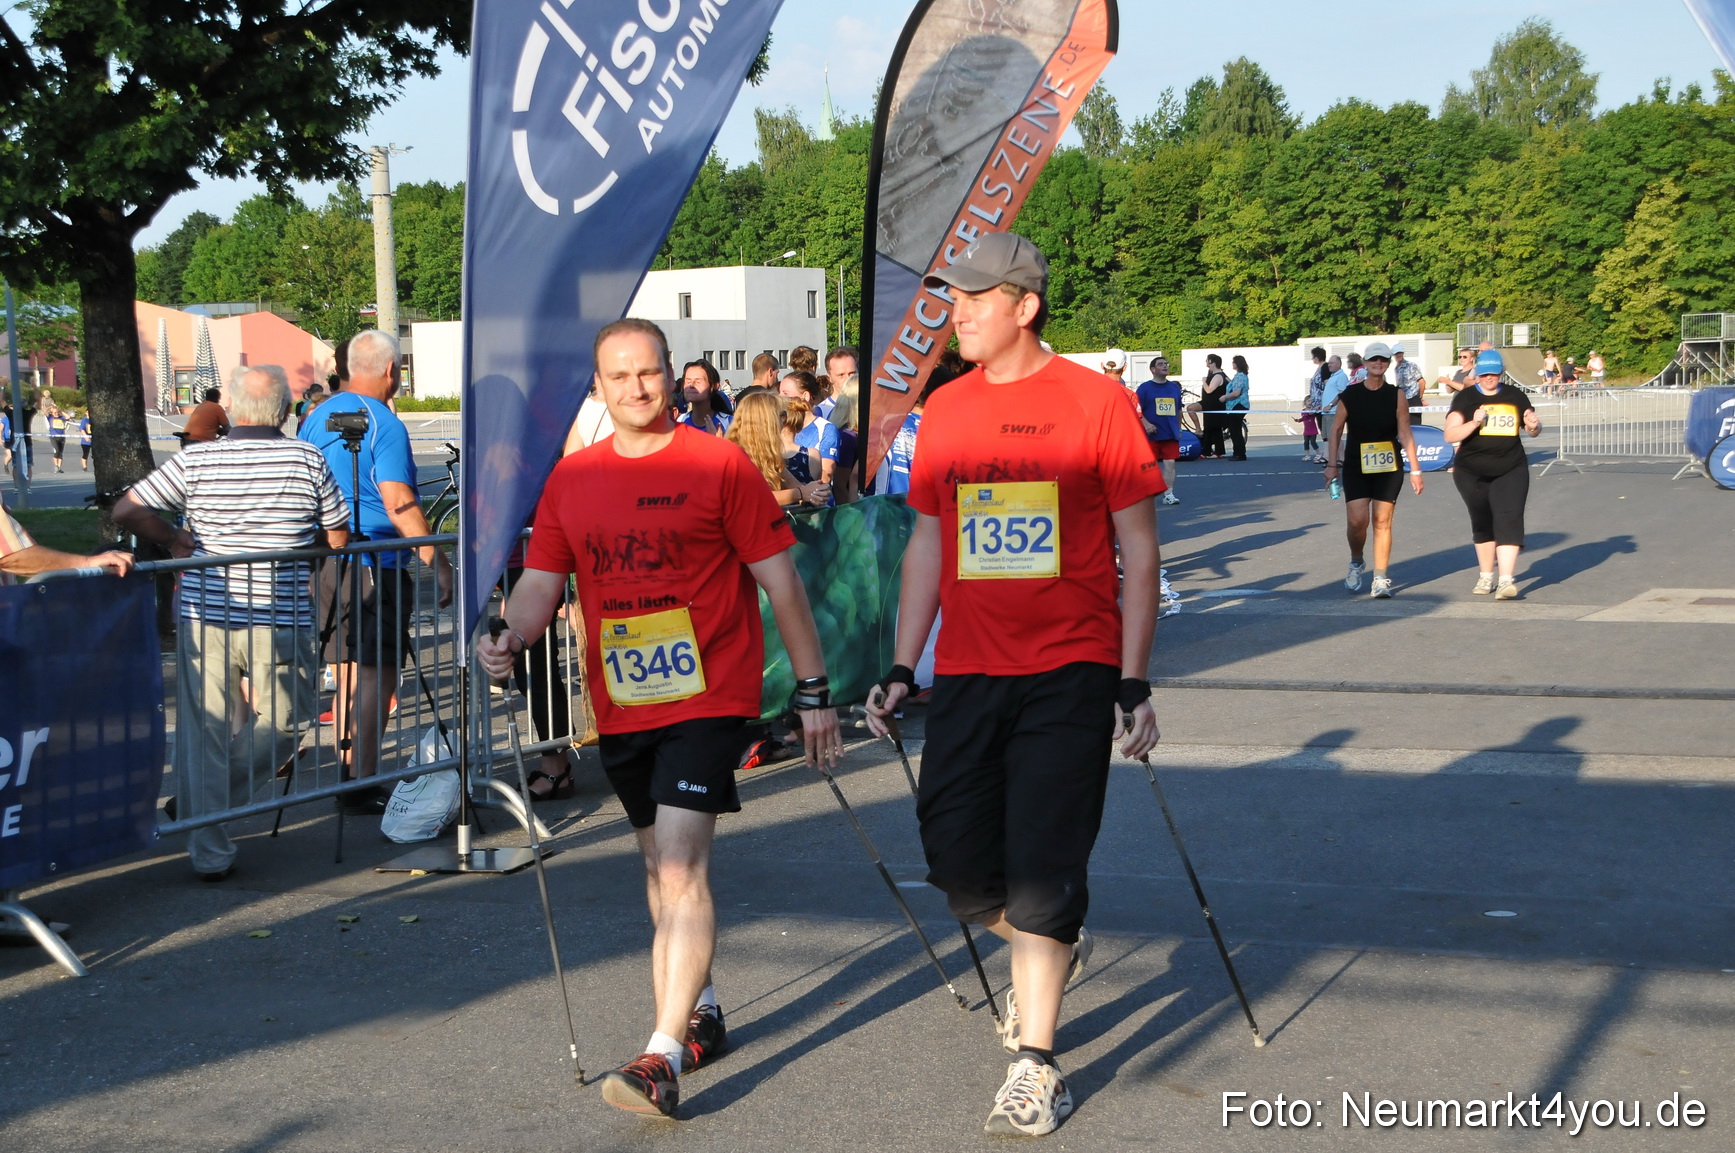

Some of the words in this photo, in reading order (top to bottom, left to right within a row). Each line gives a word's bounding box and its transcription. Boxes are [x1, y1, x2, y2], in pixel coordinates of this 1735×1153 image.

[637, 0, 730, 155] AUTOM
[1159, 403, 1172, 411] 637
[1362, 452, 1394, 465] 1136
[636, 496, 671, 507] swn
[962, 516, 1053, 555] 1352
[602, 598, 633, 611] Alles
[638, 595, 677, 609] läuft
[605, 641, 696, 683] 1346
[688, 783, 708, 794] JAKO
[2, 804, 23, 838] E
